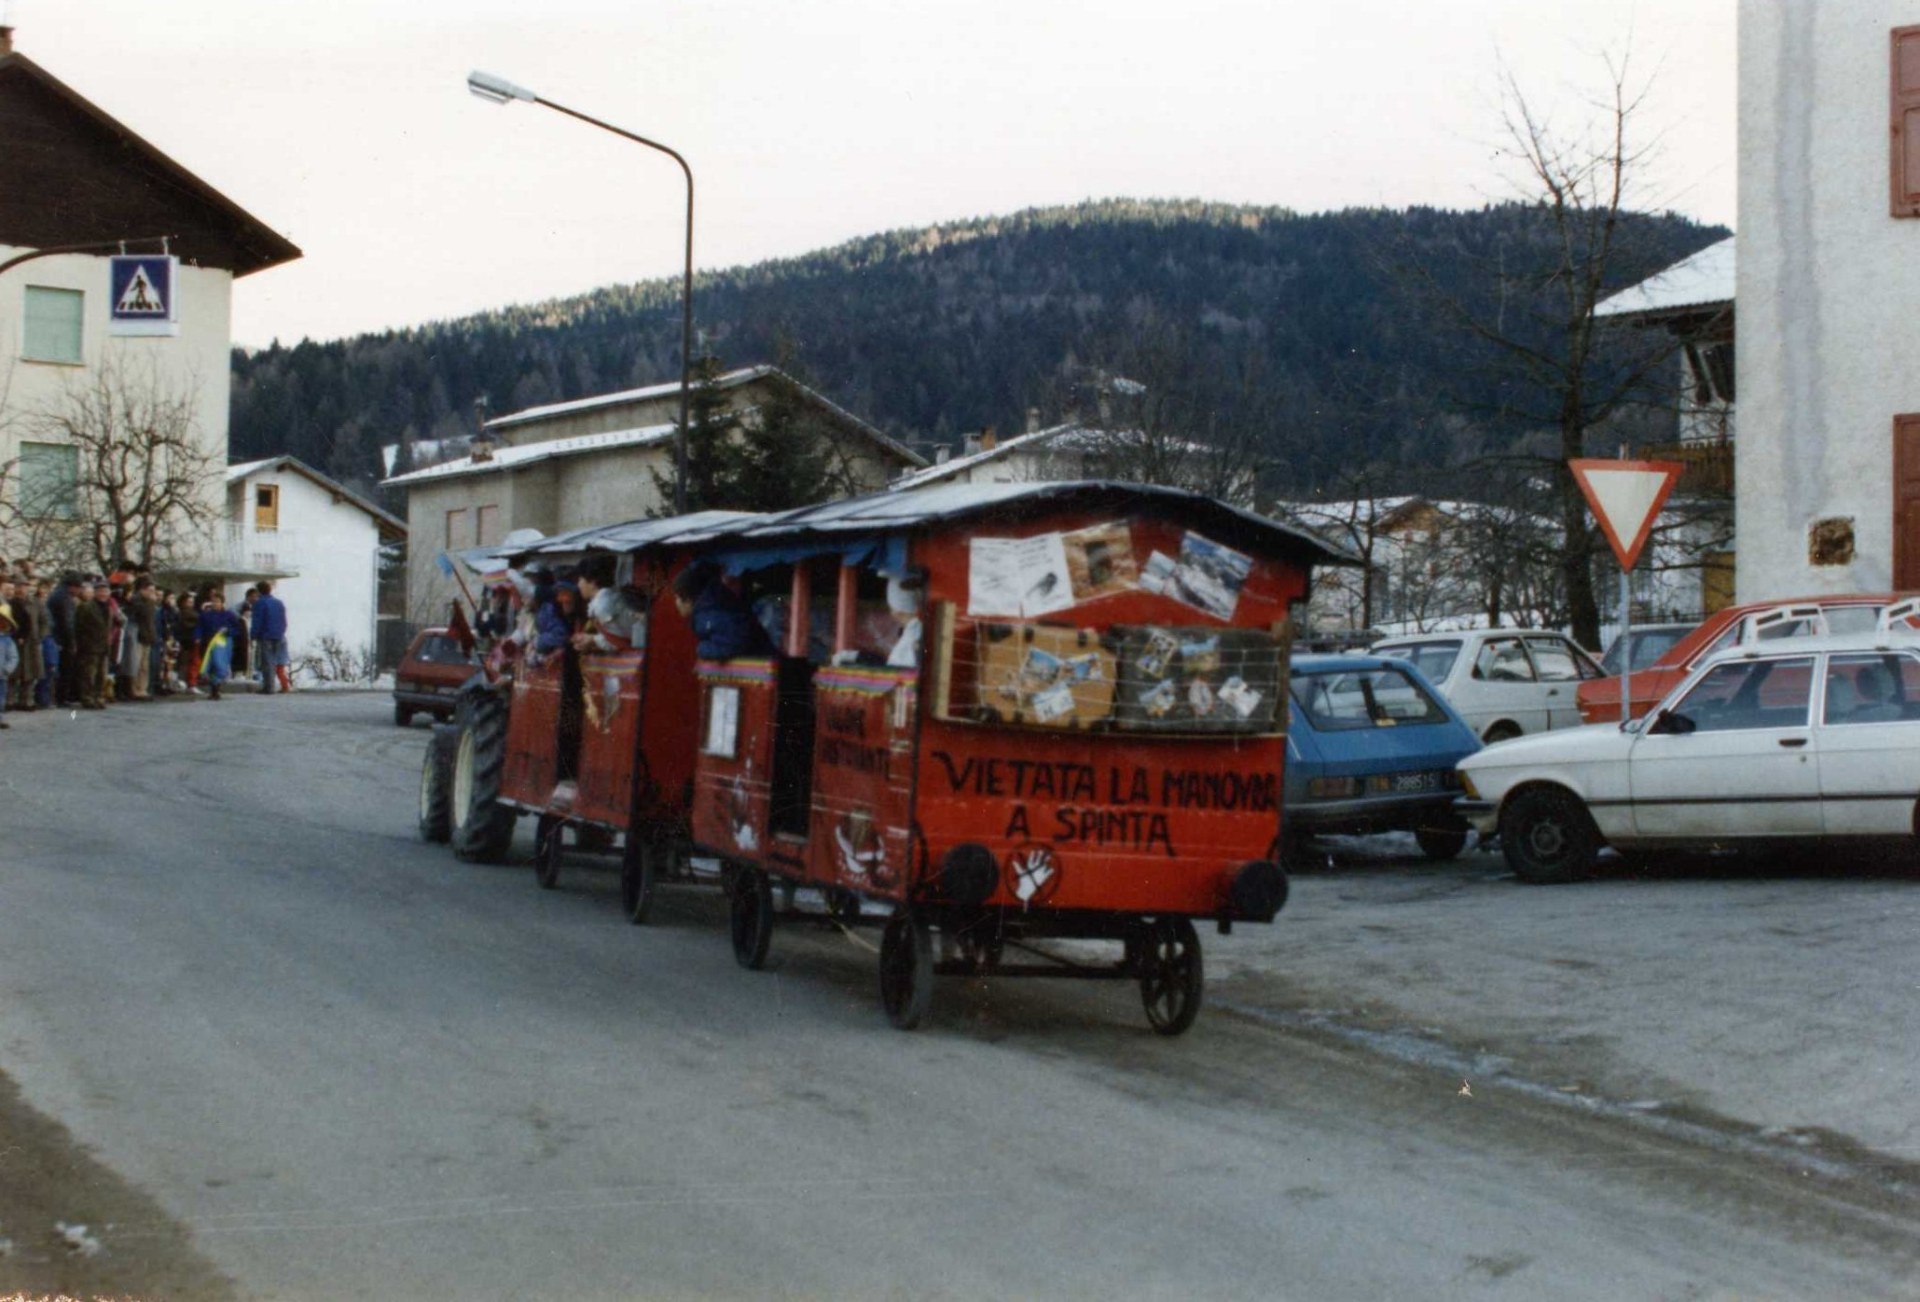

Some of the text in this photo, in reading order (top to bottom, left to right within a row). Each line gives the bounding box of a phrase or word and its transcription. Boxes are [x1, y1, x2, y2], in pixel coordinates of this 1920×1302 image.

[932, 751, 1096, 801] VIETATA
[1110, 767, 1150, 806] LA
[1006, 804, 1176, 857] A SPINTA
